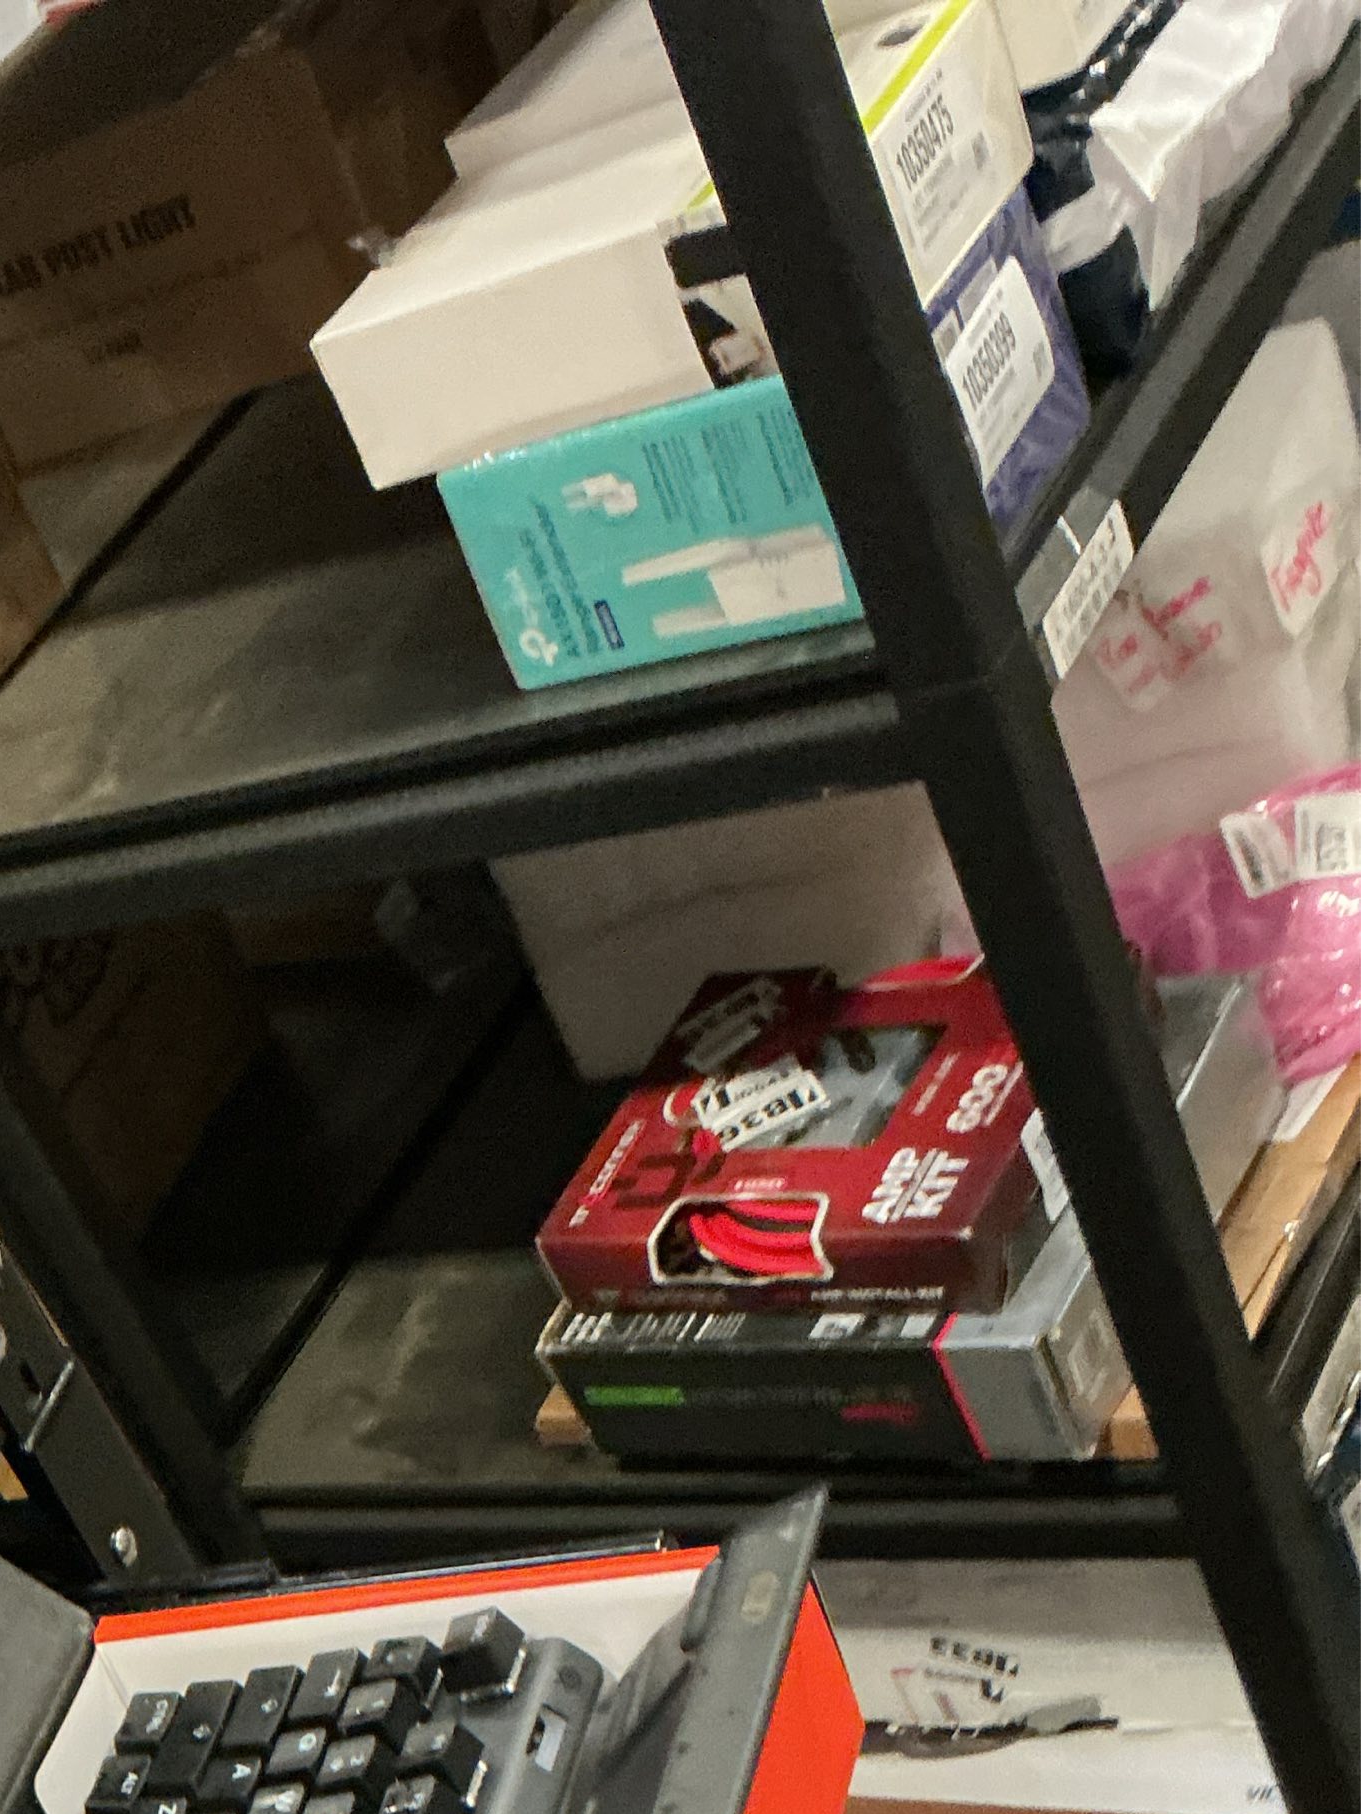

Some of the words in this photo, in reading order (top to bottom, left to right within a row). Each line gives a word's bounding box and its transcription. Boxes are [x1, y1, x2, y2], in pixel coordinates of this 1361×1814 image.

[861, 1147, 921, 1225] AMP
[903, 1150, 970, 1219] KIT
[231, 1762, 252, 1780] A
